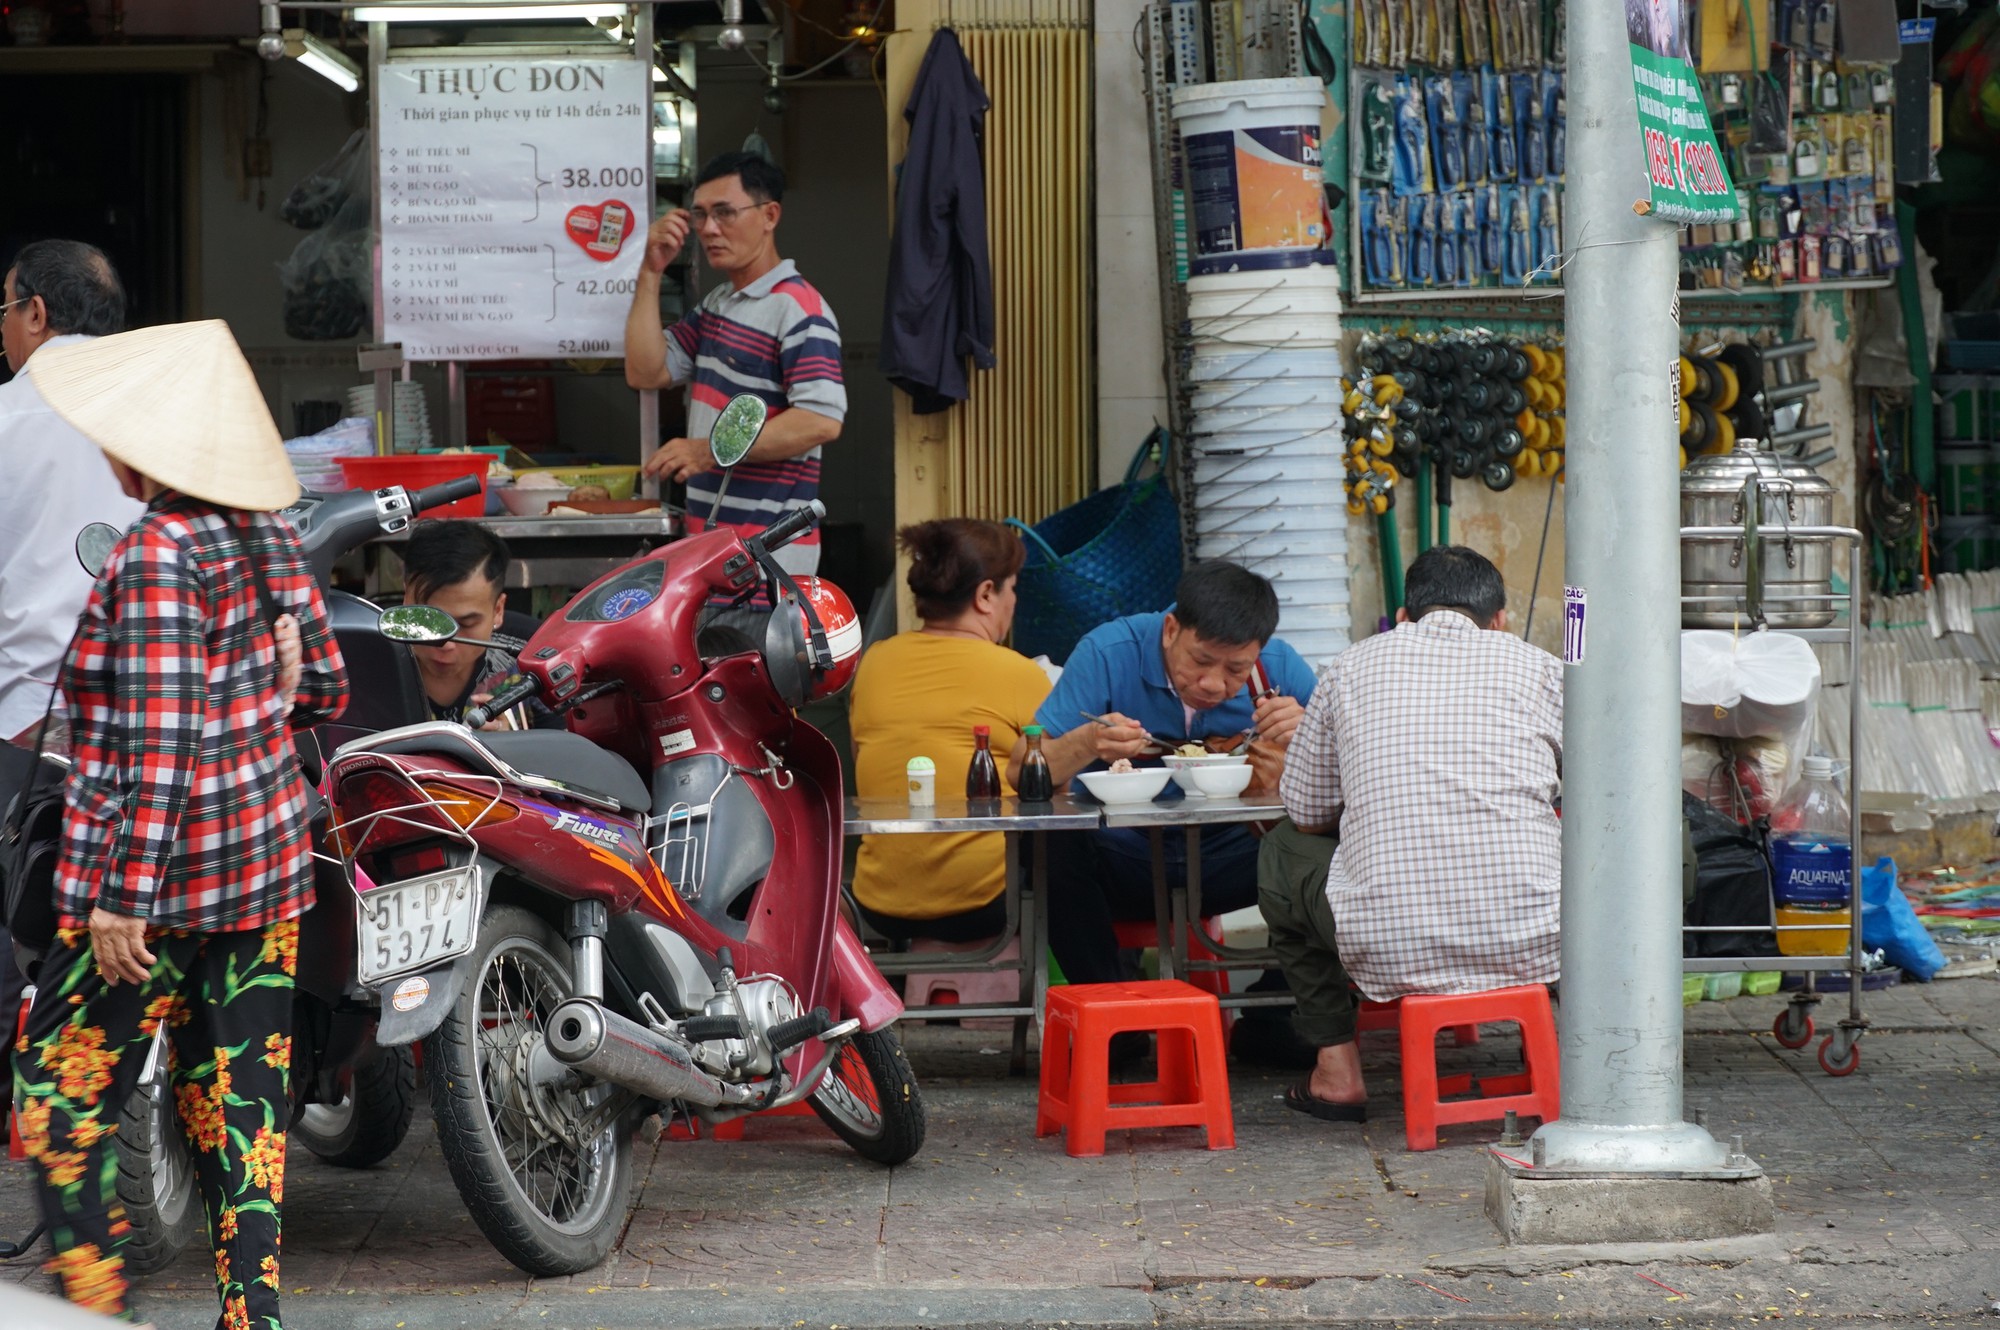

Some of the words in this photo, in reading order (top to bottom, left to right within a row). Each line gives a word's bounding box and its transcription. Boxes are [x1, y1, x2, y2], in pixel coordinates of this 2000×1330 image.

[411, 63, 517, 101] THỰC
[528, 64, 605, 92] ĐƠN
[400, 106, 435, 121] Thời
[439, 108, 469, 123] gian
[474, 107, 509, 123] phục
[514, 108, 531, 122] vụ
[535, 105, 551, 118] từ
[556, 104, 581, 118] 14h
[586, 100, 611, 117] đến
[615, 104, 641, 117] 24h
[561, 167, 643, 188] 38.000
[408, 247, 414, 256] 2
[576, 279, 637, 295] 42.000
[557, 339, 610, 353] 52.000
[342, 759, 377, 772] HONDA
[594, 839, 614, 850] HONDA
[1788, 868, 1846, 886] AQUAFINA
[376, 919, 455, 970] 5374
